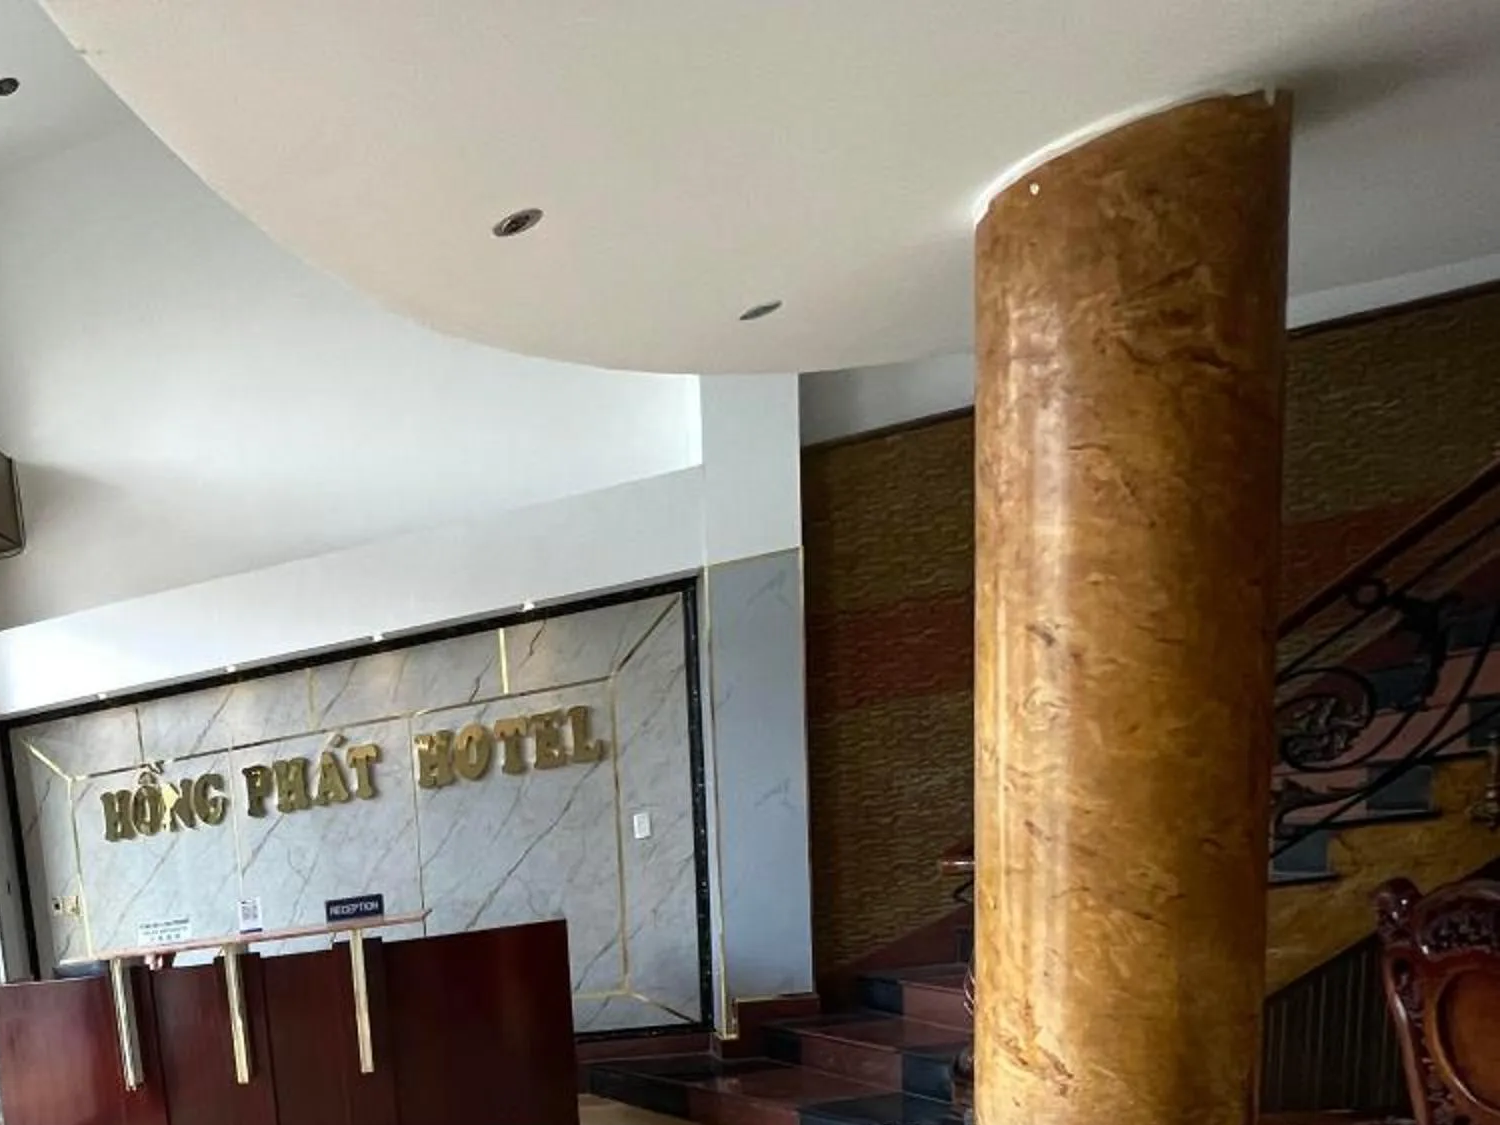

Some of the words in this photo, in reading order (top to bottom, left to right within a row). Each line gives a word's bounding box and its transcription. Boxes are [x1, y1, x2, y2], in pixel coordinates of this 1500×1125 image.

[101, 762, 228, 842] HỒNG
[242, 733, 380, 818] PHÁT
[413, 705, 605, 789] HOTEL
